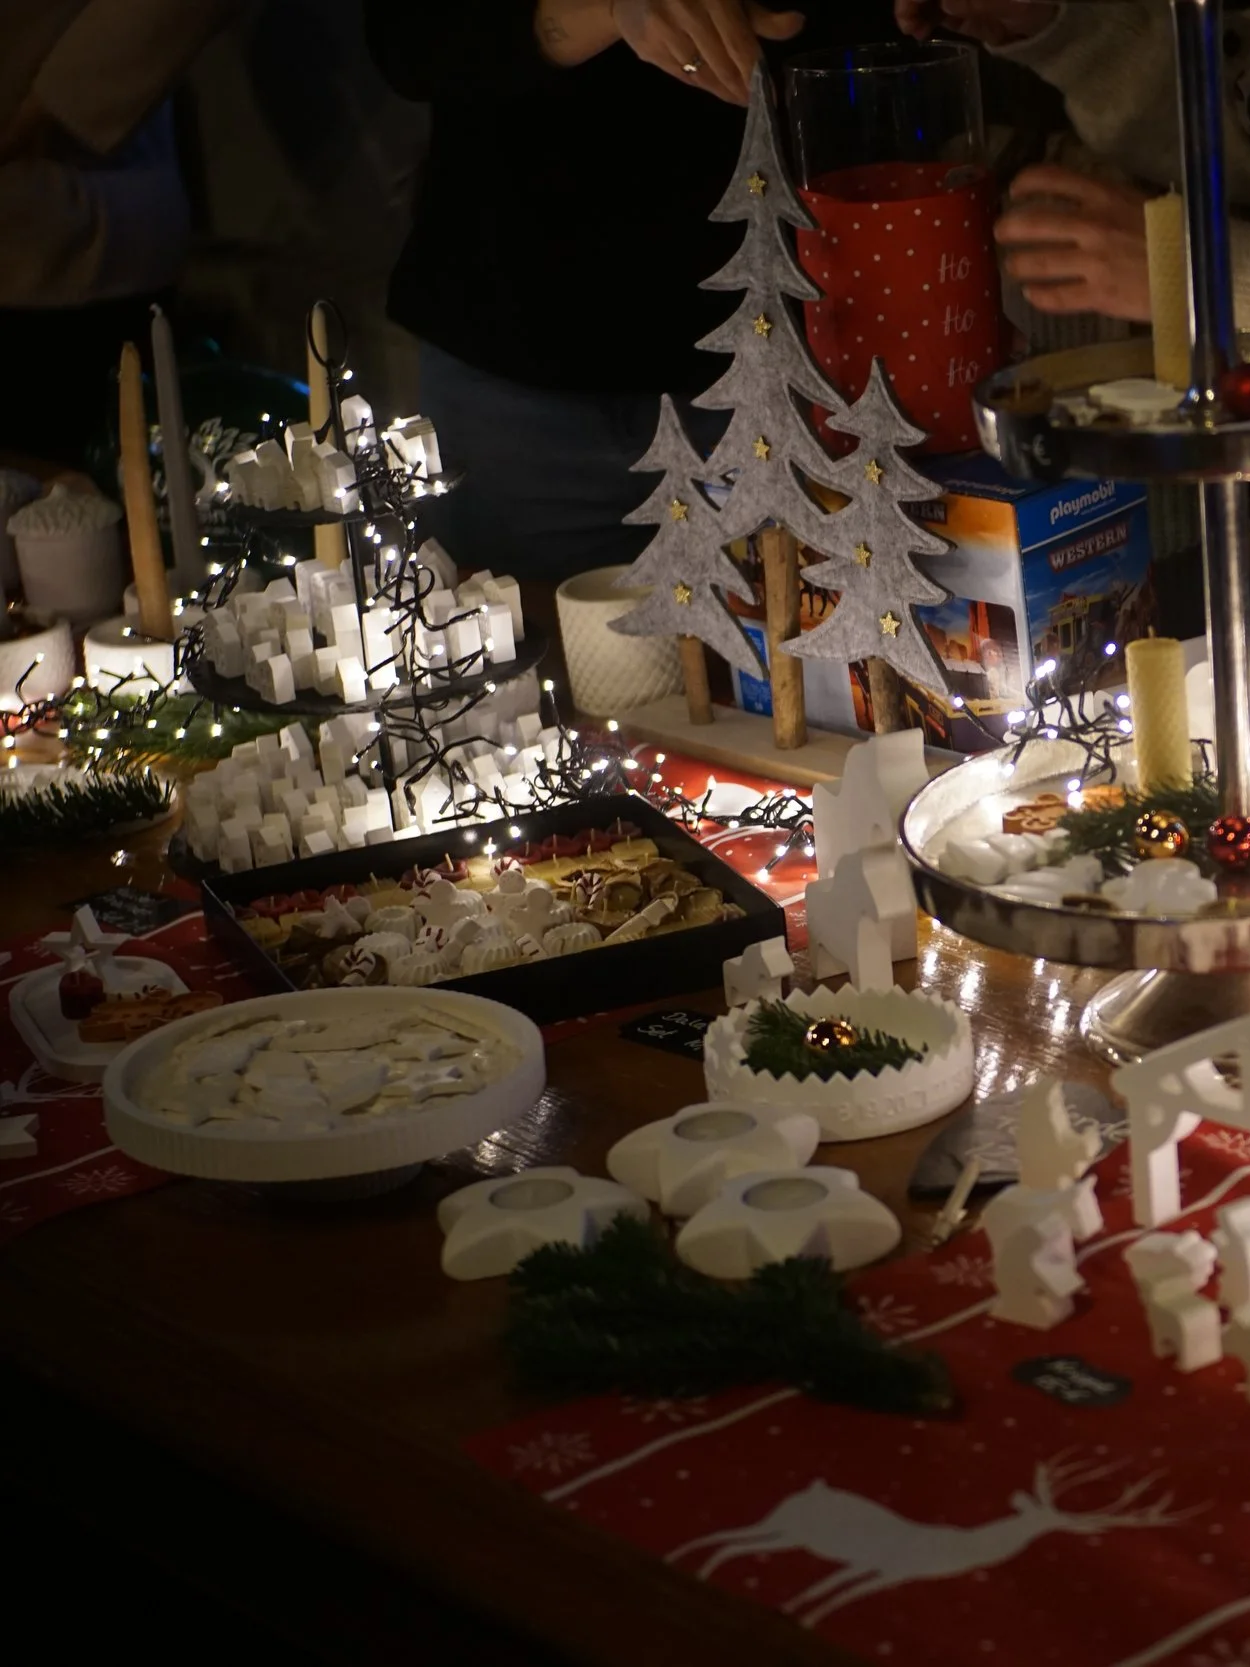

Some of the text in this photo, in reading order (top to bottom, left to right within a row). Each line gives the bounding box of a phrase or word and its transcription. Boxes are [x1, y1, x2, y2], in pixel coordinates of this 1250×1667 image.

[937, 253, 972, 284] Ho
[942, 304, 976, 336] Ho
[946, 356, 980, 388] Ho
[1050, 480, 1115, 525] playmobil
[1050, 523, 1127, 570] WESTERN
